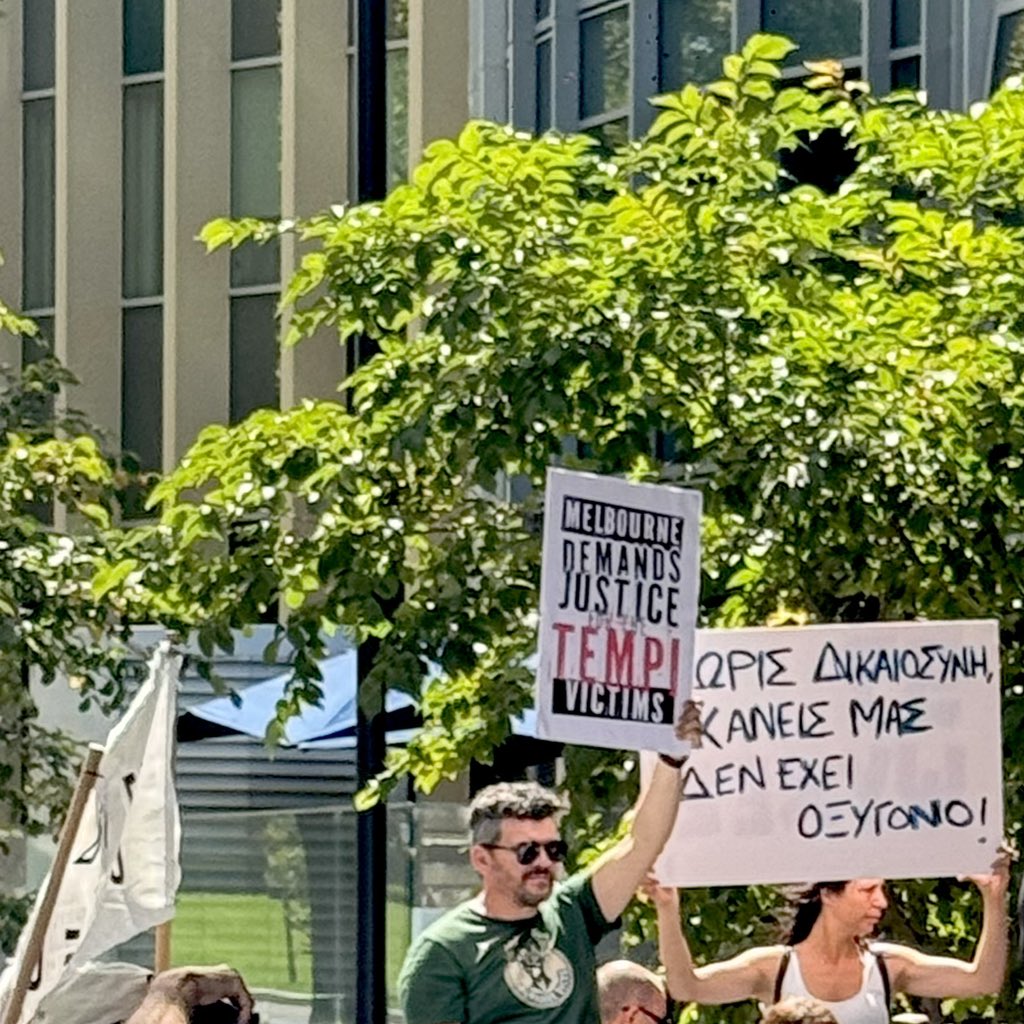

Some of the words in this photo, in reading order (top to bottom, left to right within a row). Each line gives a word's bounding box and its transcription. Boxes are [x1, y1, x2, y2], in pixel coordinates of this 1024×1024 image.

[563, 499, 681, 546] MELBOURNE
[562, 539, 681, 583] DEMANDS
[558, 571, 680, 627] JUSTICE
[552, 621, 680, 697] TEMPI
[694, 647, 796, 691] ΩΡΙΣ
[565, 680, 665, 724] VICTIMS
[849, 695, 933, 739] ΜΑΣ
[681, 755, 766, 799] ΔΕΝ
[777, 754, 853, 791] ΕΧΕΙ
